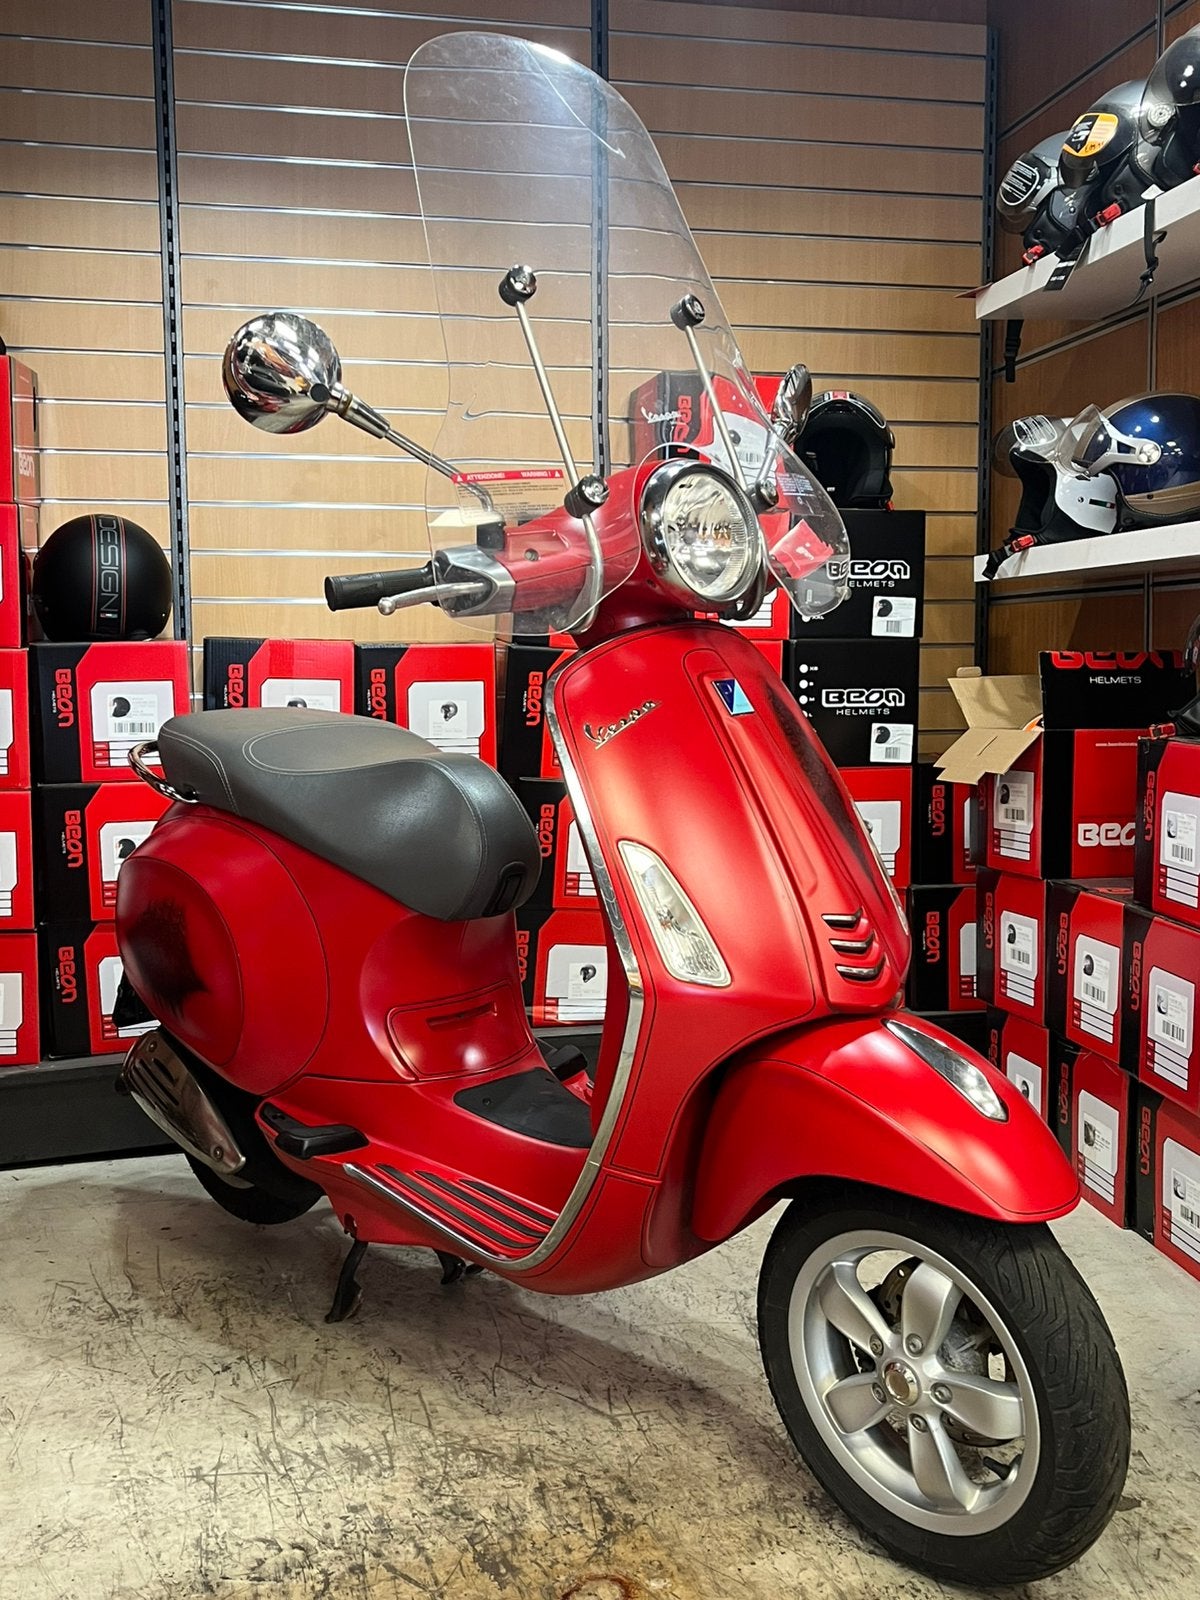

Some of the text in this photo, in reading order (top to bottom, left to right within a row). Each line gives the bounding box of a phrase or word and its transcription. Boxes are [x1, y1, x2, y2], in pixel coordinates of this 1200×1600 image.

[98, 515, 121, 613] DESIGN
[1089, 676, 1141, 684] HELMETS
[583, 700, 662, 750] Vespa
